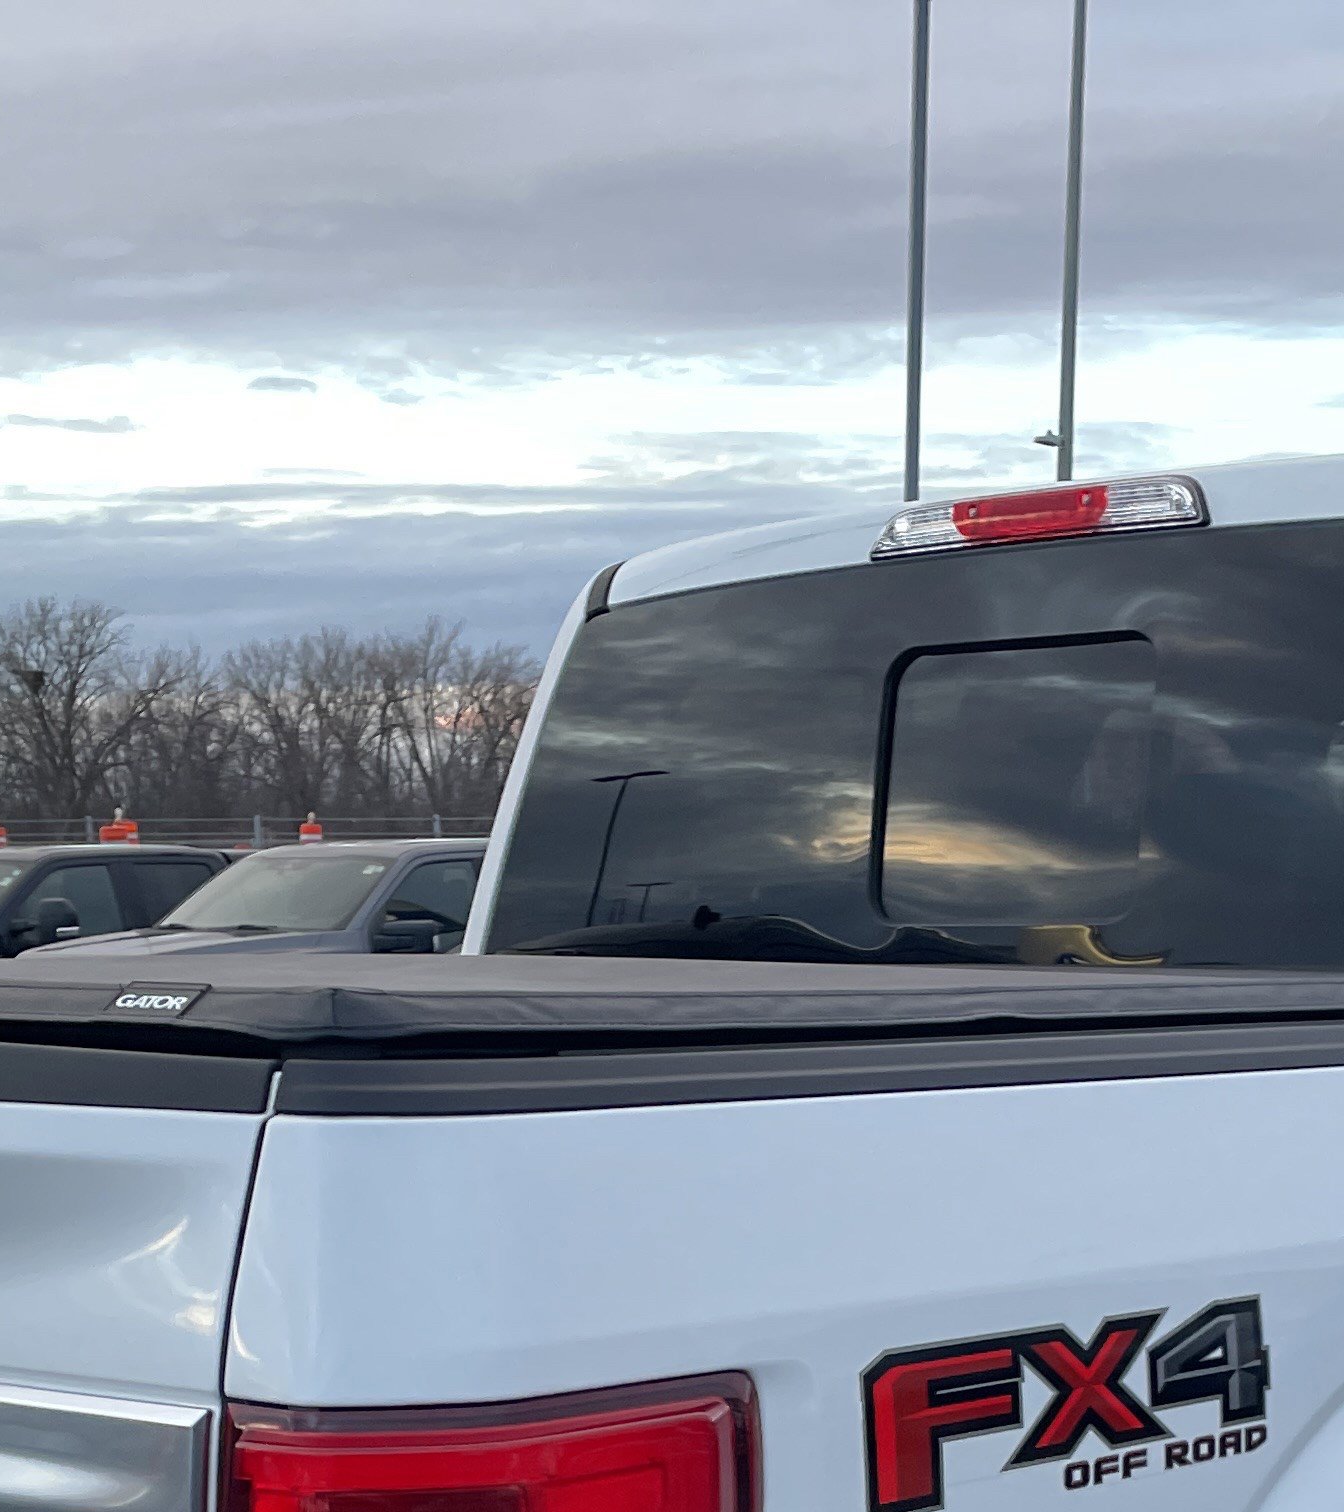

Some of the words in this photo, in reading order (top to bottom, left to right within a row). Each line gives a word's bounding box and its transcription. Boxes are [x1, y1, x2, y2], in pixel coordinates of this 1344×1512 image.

[115, 993, 189, 1010] GATOR
[1064, 1449, 1149, 1491] OFF
[1164, 1424, 1269, 1469] ROAD
